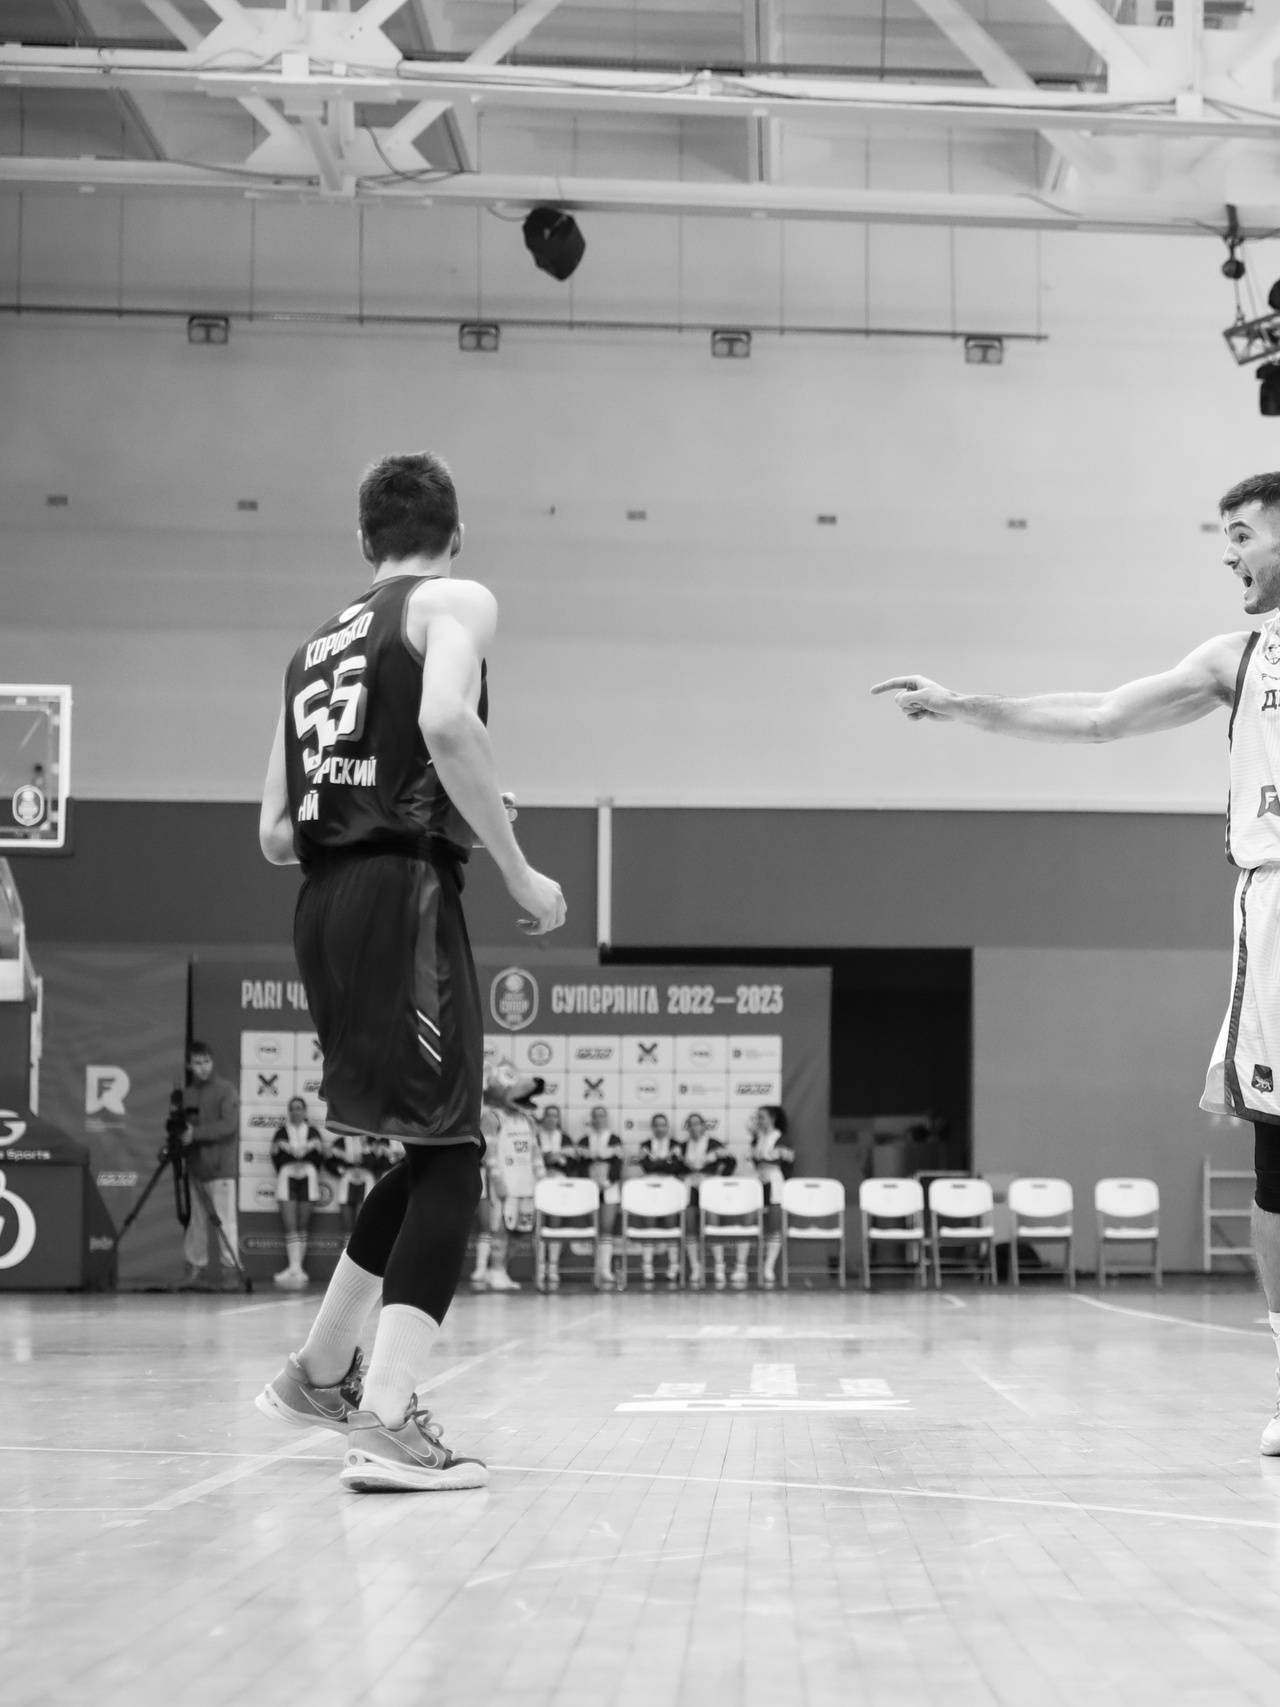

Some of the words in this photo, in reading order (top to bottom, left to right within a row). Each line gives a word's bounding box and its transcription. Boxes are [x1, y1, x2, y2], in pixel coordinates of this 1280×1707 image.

[304, 611, 375, 671] КОРОБКО
[293, 654, 368, 777] 55
[241, 980, 283, 1010] PARI
[551, 984, 659, 1014] СУПЕРЛИГА
[6, 1149, 51, 1161] Sports
